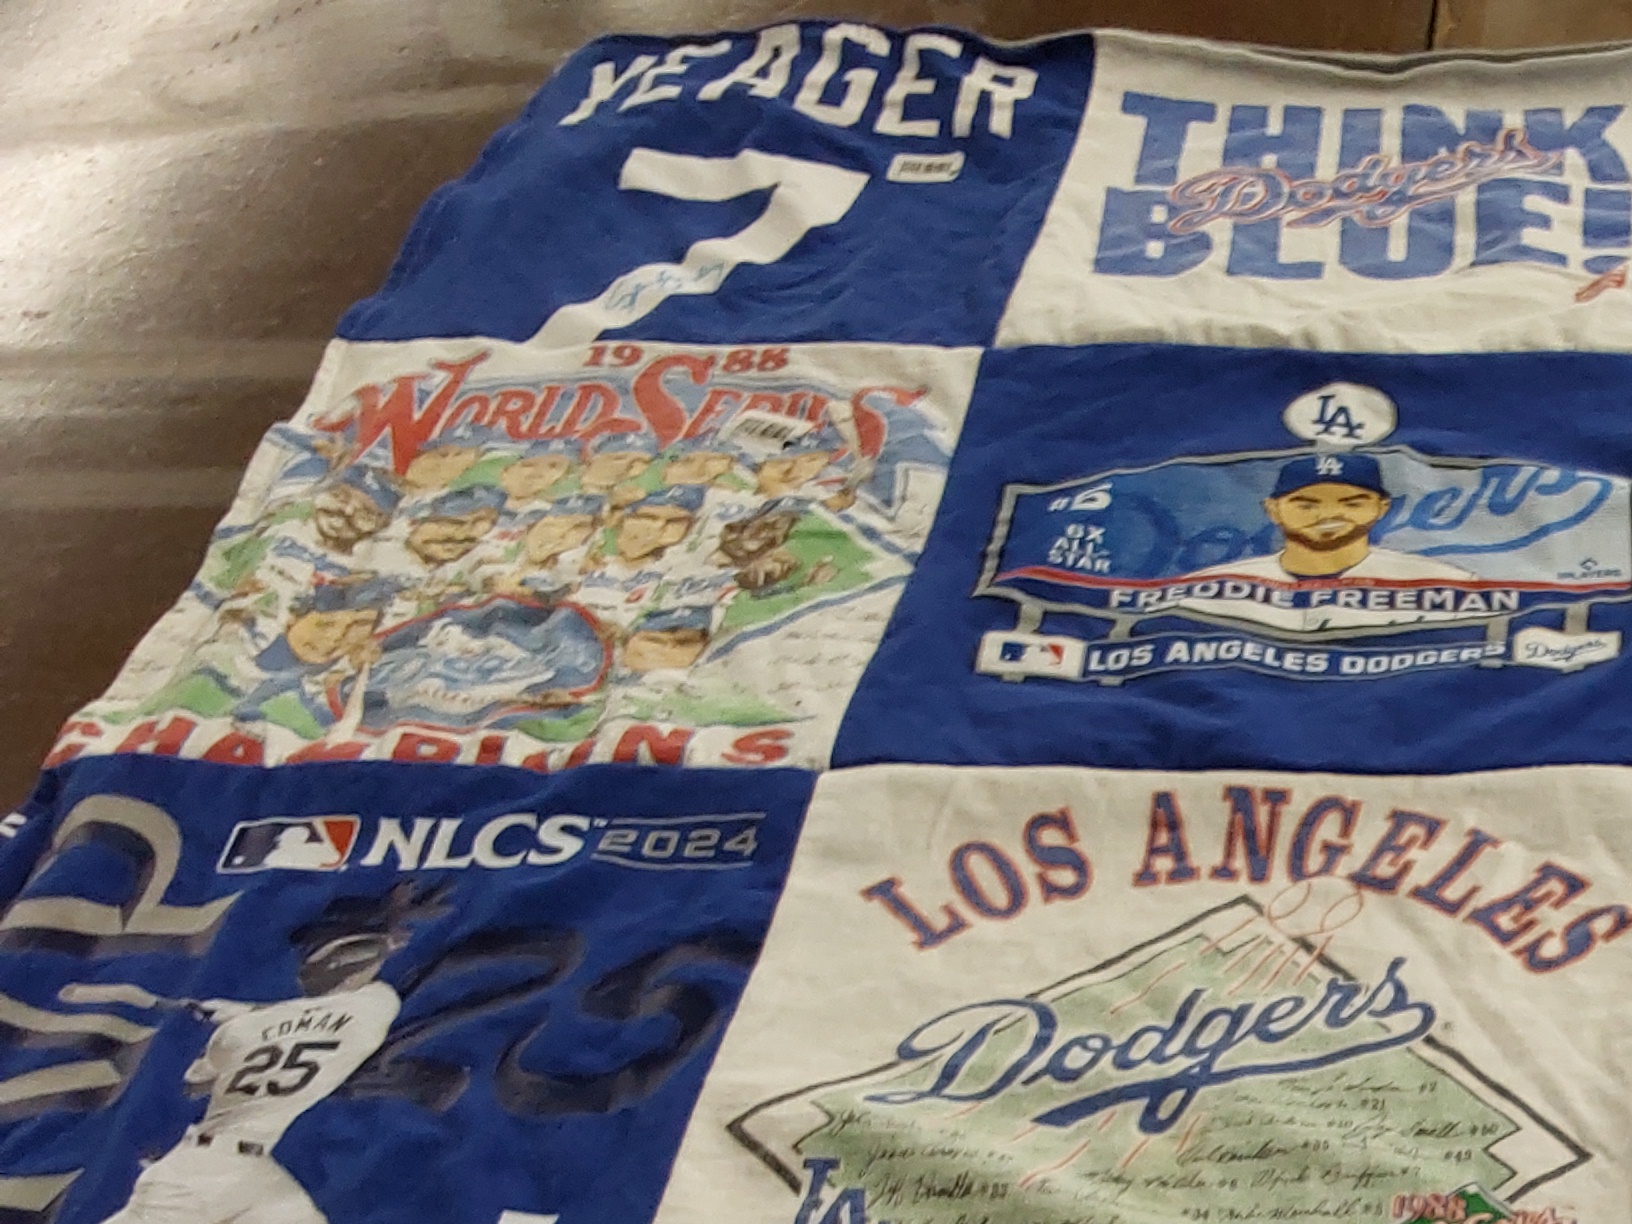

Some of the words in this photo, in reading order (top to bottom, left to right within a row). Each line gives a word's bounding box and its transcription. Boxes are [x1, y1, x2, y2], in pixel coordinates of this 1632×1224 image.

[558, 22, 1037, 139] YEAGER
[1121, 91, 1632, 186] THINK
[1168, 126, 1563, 230] Dodgers
[520, 147, 870, 347] 7
[582, 345, 646, 370] 19
[721, 346, 791, 373] 88
[310, 351, 648, 476] WORLD
[1311, 394, 1363, 439] LA
[1109, 580, 1294, 612] FREDDIE
[1310, 588, 1520, 613] FREEMAN
[1088, 640, 1153, 673] LOS
[1164, 640, 1329, 676] ANGELES
[1339, 641, 1506, 676] DODGERS
[360, 813, 602, 870] NLCS
[600, 828, 760, 860] 2024
[862, 805, 1094, 951] LOS
[230, 1042, 341, 1097] 25
[862, 955, 1438, 1135] Dodgers
